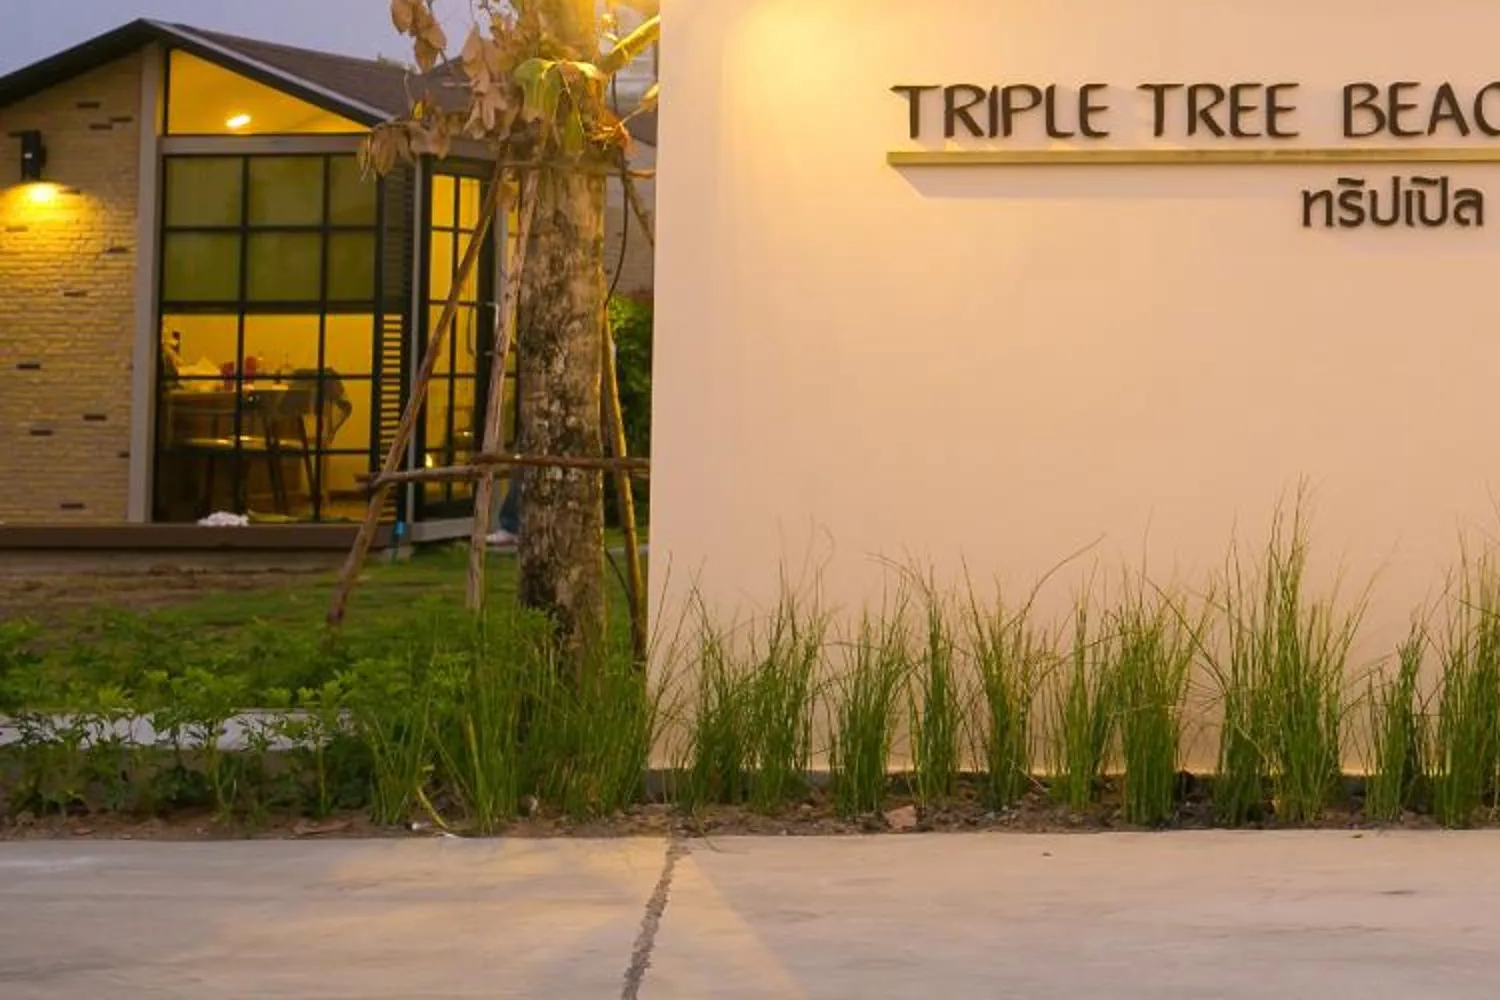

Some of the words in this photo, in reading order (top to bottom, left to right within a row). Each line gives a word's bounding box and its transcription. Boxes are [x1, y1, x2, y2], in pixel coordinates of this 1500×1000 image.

[890, 83, 1111, 139] TRIPLE
[1136, 82, 1300, 138] TREE
[1300, 175, 1485, 229] ทริปเปิล
